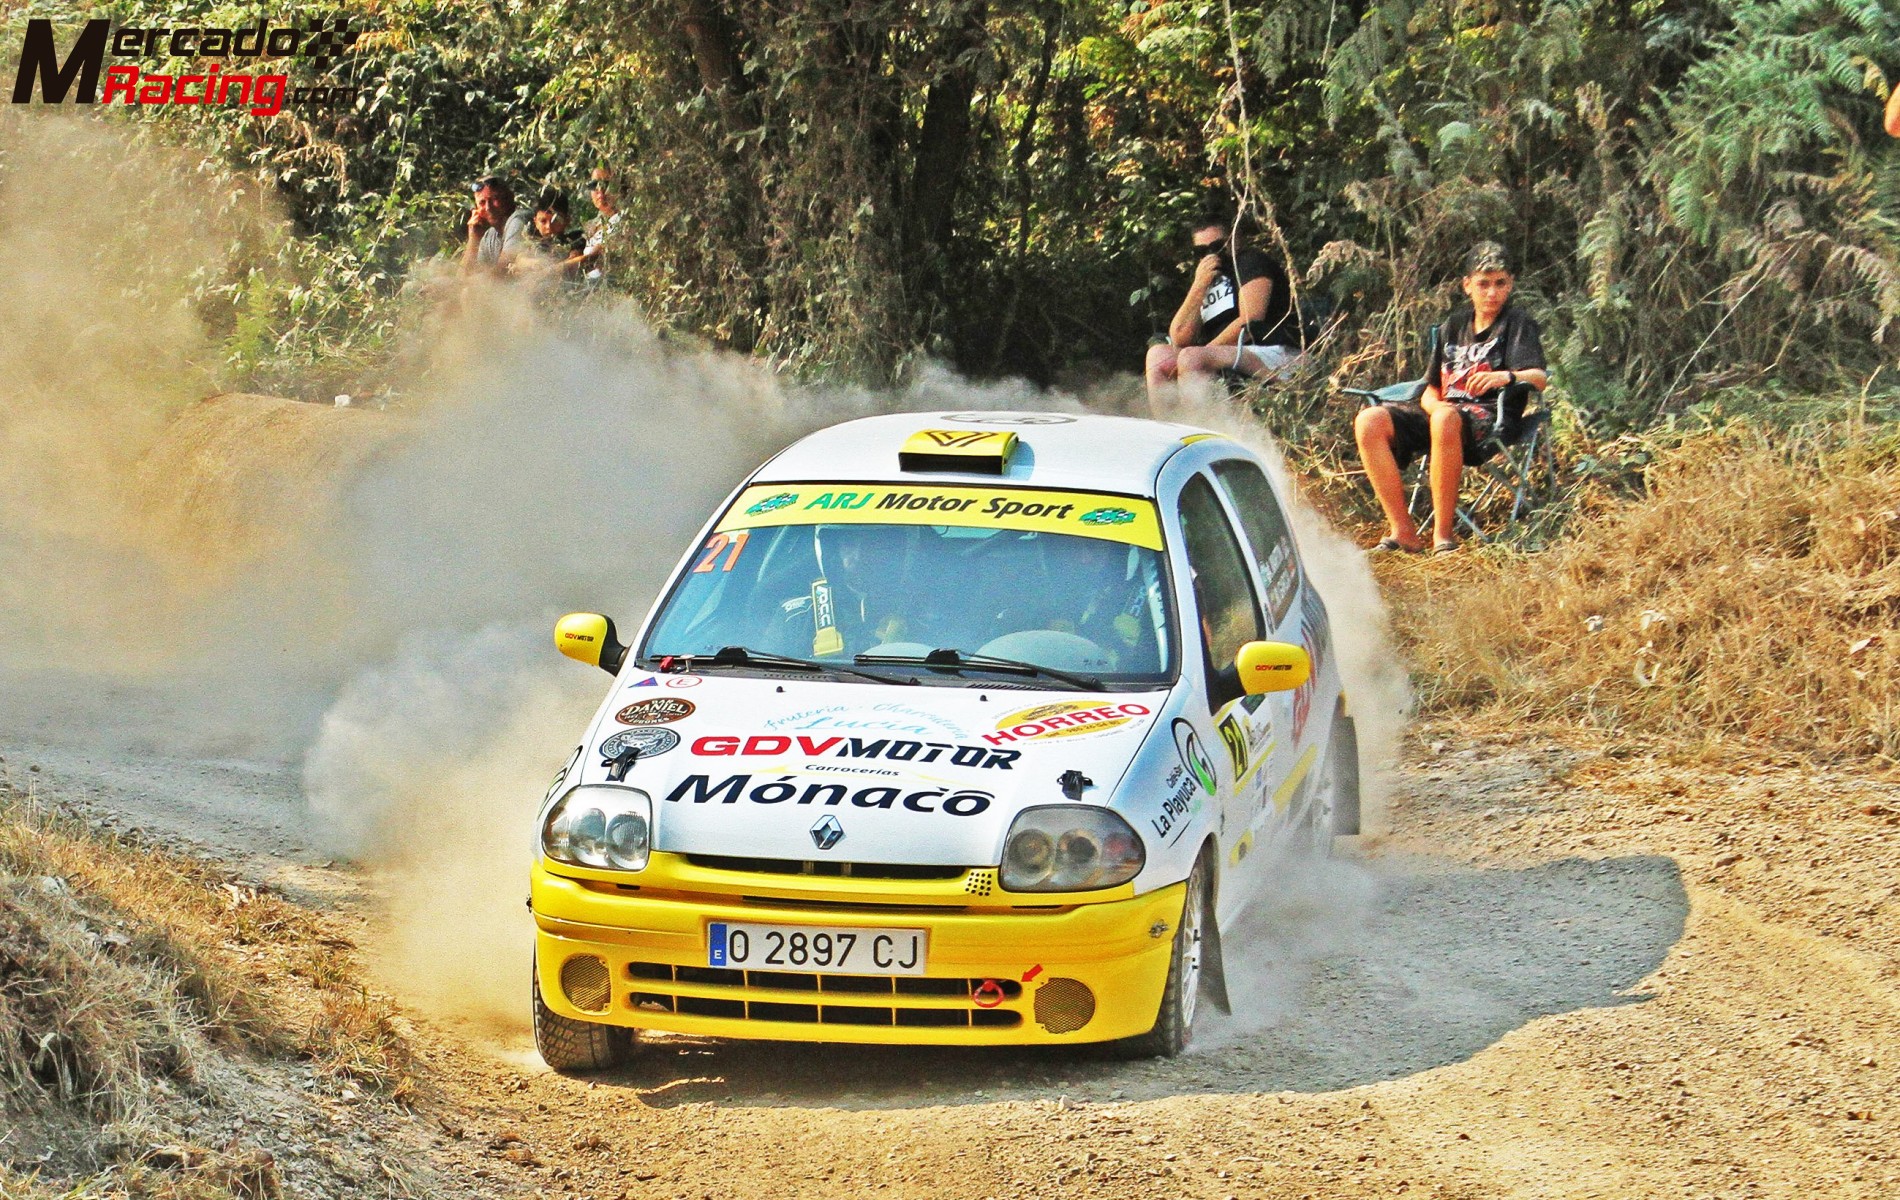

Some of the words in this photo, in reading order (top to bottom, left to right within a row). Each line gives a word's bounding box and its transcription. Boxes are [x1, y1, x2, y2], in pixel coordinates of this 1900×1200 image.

[803, 493, 875, 510] ARJ
[876, 493, 977, 512] Motor
[981, 497, 1074, 519] Sport
[692, 532, 750, 573] 21
[621, 700, 688, 716] DANIEL
[981, 703, 1151, 745] HORREO
[804, 764, 900, 777] Carrocerías
[1151, 815, 1171, 838] La
[1162, 777, 1197, 822] Playuca
[713, 949, 723, 960] E
[764, 931, 857, 967] 2897
[872, 933, 918, 969] CJ
